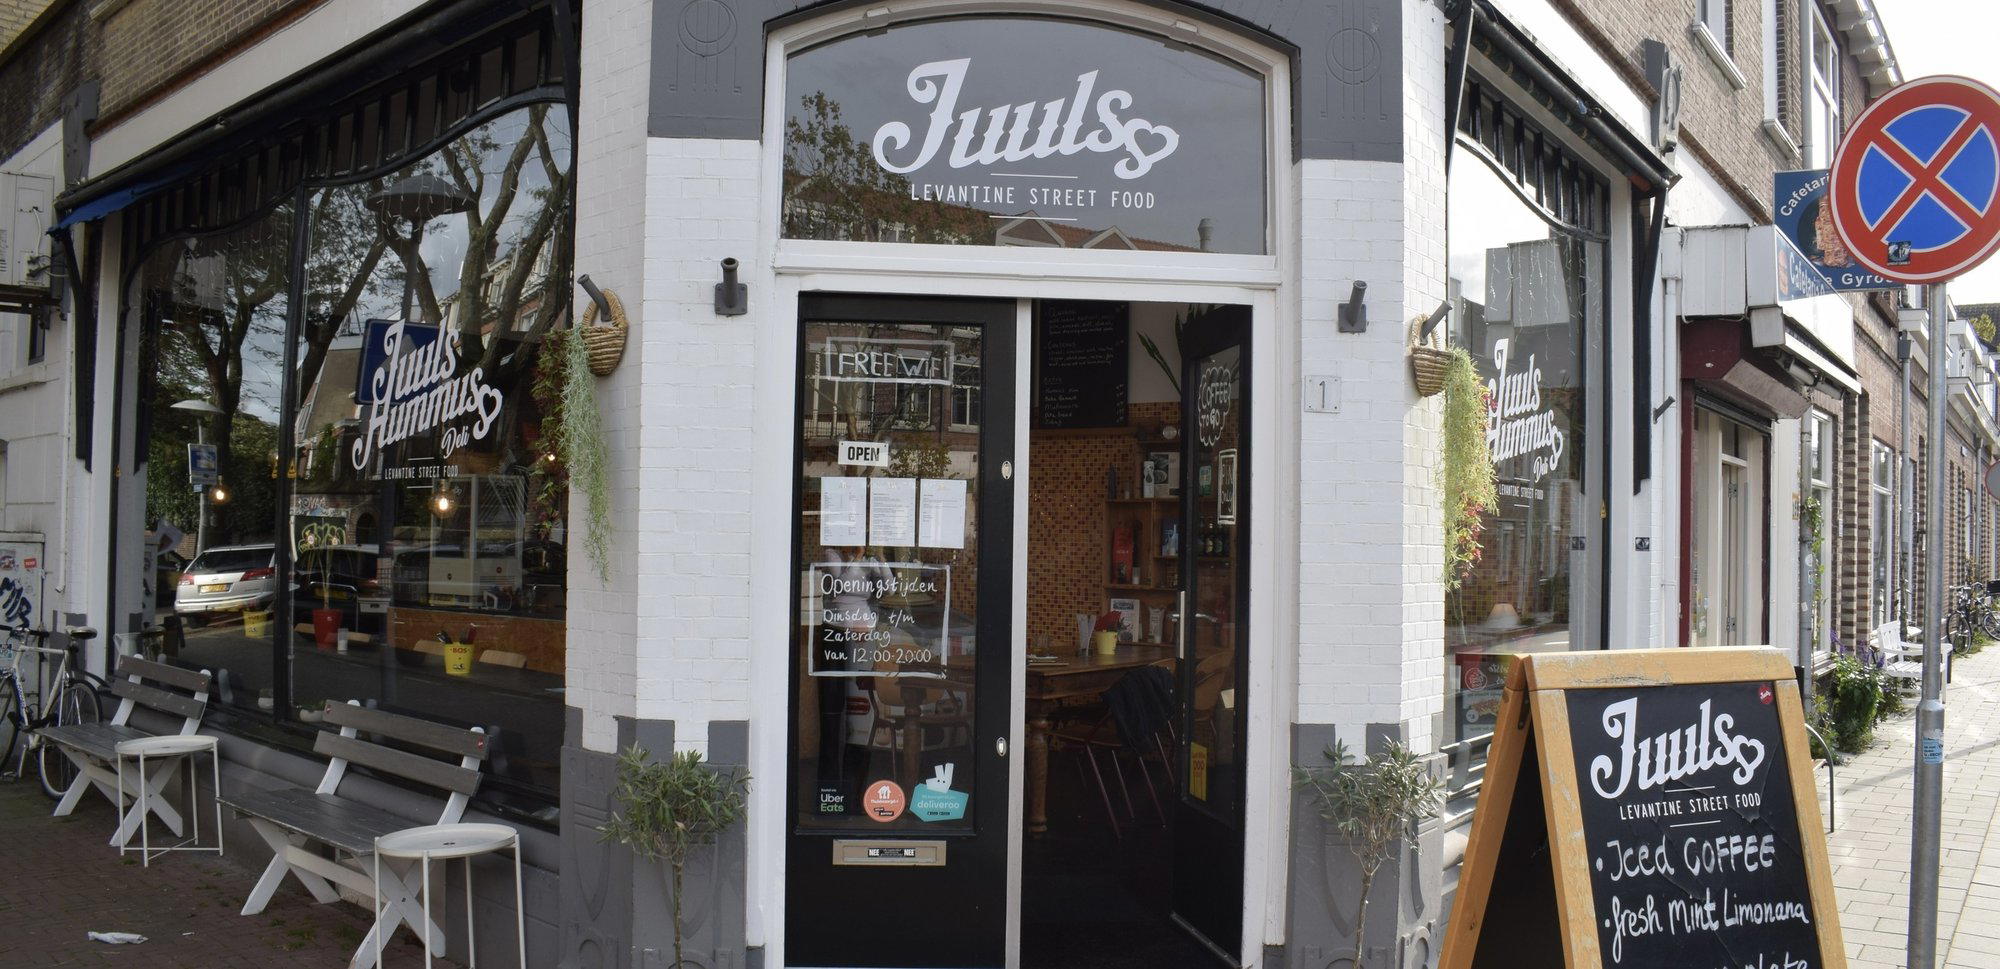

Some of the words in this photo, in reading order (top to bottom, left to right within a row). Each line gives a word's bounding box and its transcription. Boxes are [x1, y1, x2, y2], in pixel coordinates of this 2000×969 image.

[873, 57, 1180, 180] Juuls
[910, 183, 1016, 204] LEVANTINE
[1029, 187, 1097, 207] STREET
[1110, 191, 1155, 210] FOOD
[1780, 173, 1830, 217] Cafetari
[373, 316, 459, 405] Juuls
[838, 351, 894, 377] FREE
[1488, 338, 1541, 418] Juuls
[1201, 381, 1229, 410] COFFEE
[1319, 381, 1326, 409] 1
[352, 367, 503, 471] Hummus
[1201, 414, 1209, 427] TO
[1209, 408, 1221, 429] GO
[441, 425, 470, 459] Deli
[847, 446, 880, 462] OPEN
[1486, 410, 1563, 471] Hummus
[384, 466, 416, 480] LEVANTINE
[418, 465, 440, 479] STREET
[443, 464, 459, 478] FOOD
[820, 573, 938, 599] Openingstijden
[823, 608, 877, 628] Dinsdag
[888, 609, 915, 628] t/m
[823, 628, 891, 648] Zaterdag
[824, 649, 848, 661] van
[1590, 696, 1765, 799] Juuls
[820, 793, 845, 803] Uber
[820, 803, 844, 813] Eats
[917, 798, 960, 810] deliveroo
[1619, 800, 1683, 821] LEVANTINE
[1690, 795, 1729, 813] STREET
[1735, 792, 1761, 807] FOOD
[1683, 834, 1776, 877] COFFEE
[1724, 887, 1810, 927] Limonana
